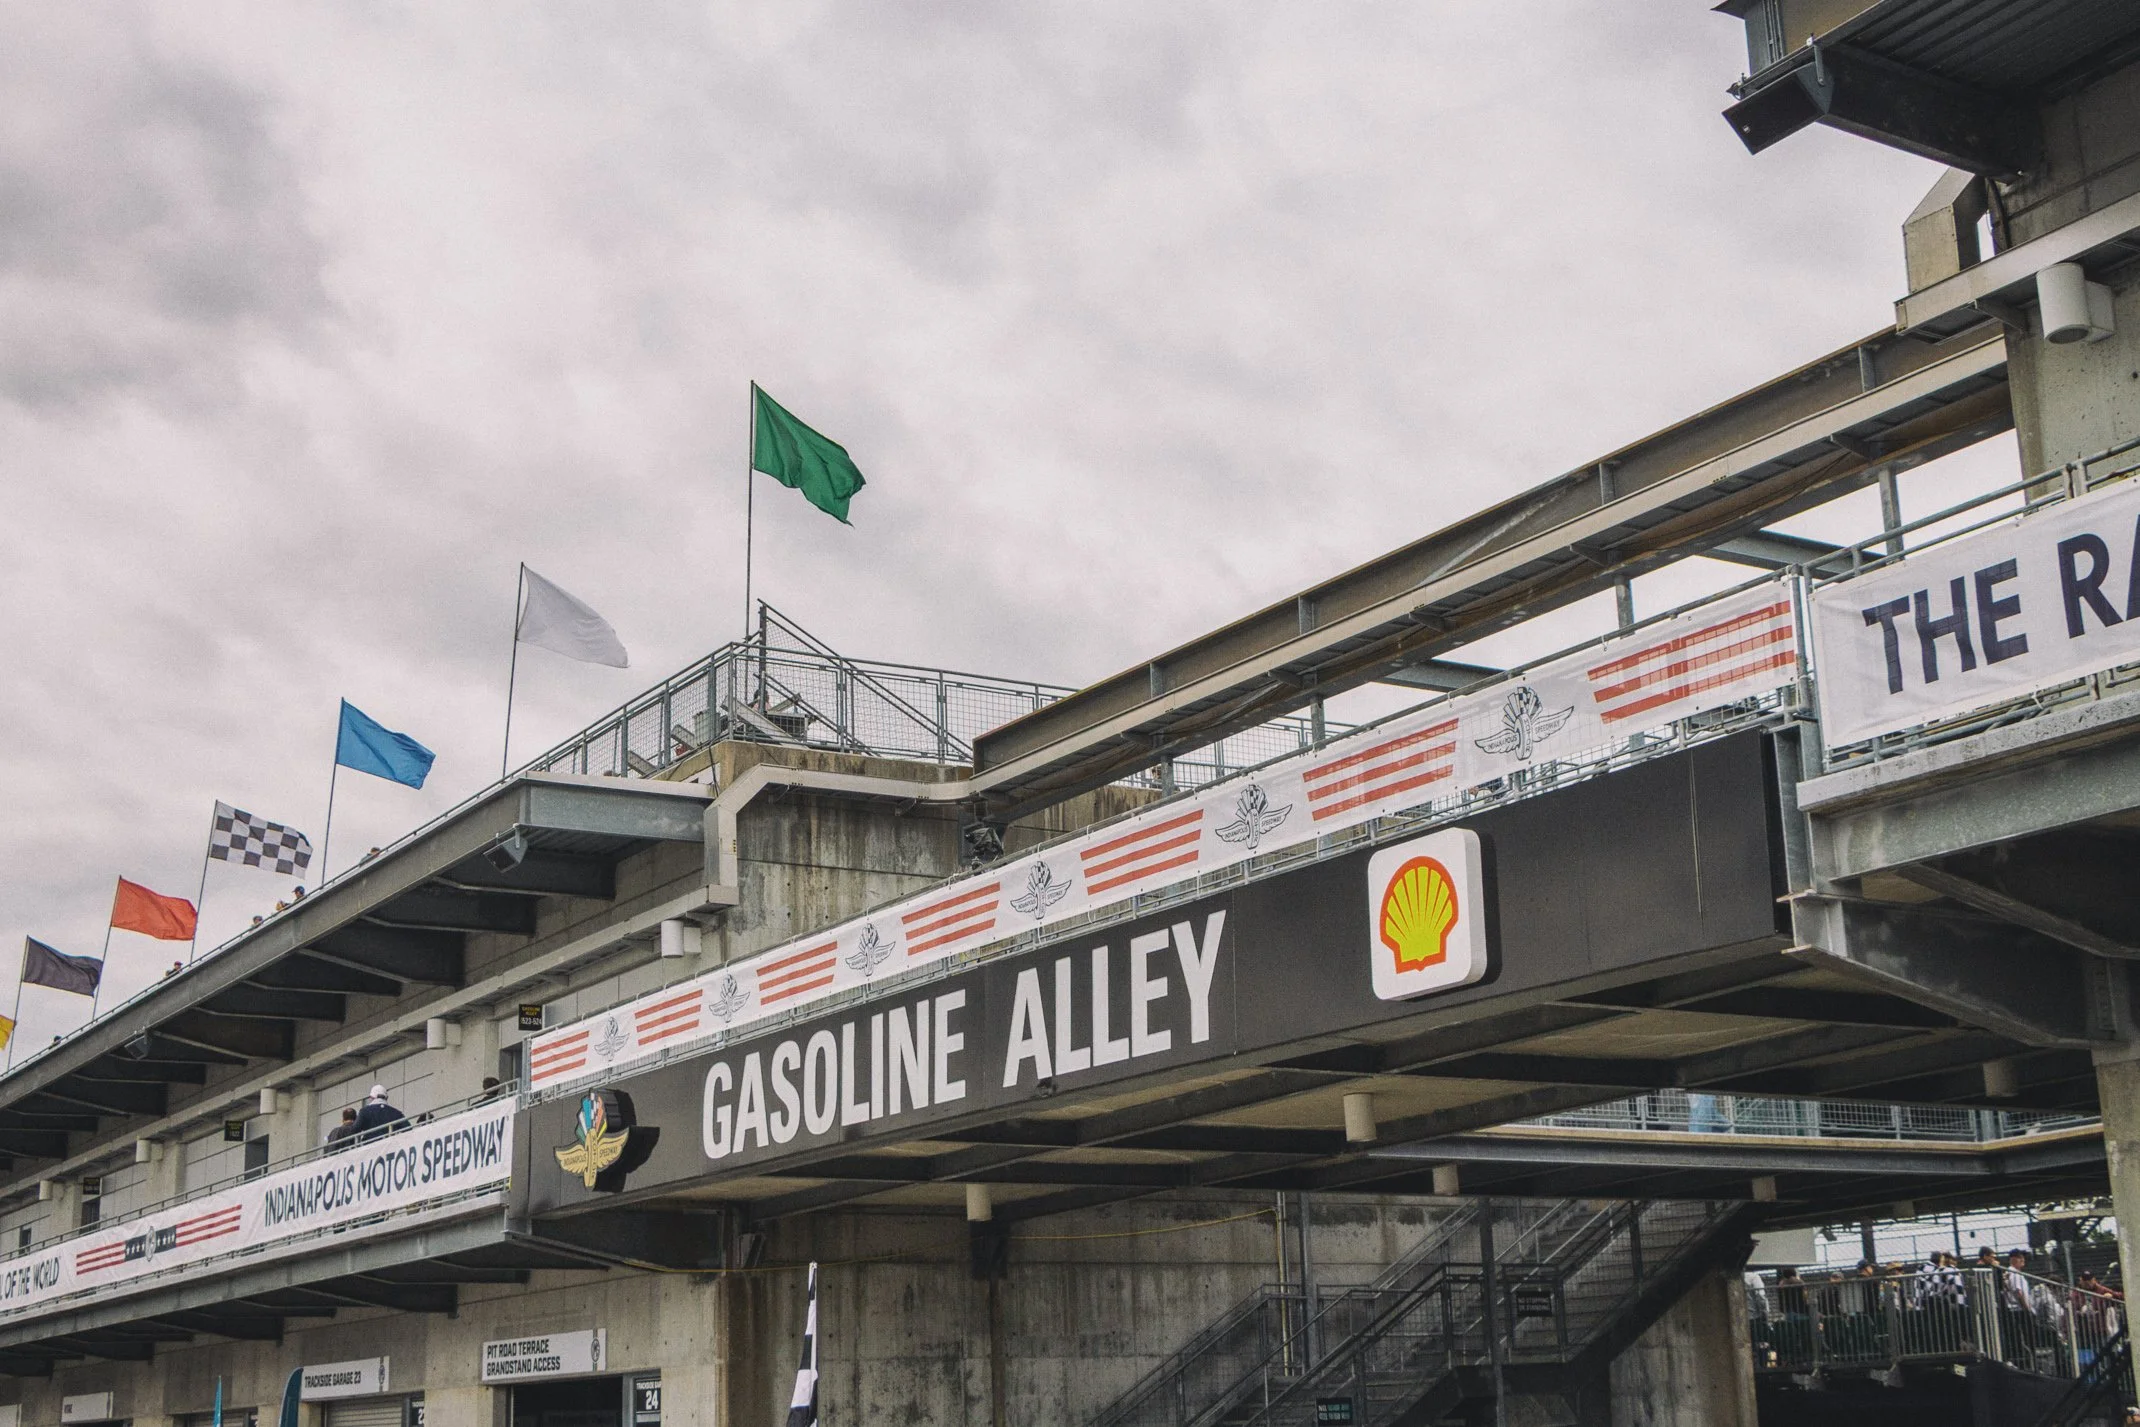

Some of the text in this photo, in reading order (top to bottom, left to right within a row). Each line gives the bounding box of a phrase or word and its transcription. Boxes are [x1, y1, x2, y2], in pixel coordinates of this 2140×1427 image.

[1862, 513, 2140, 695] THE R
[702, 909, 1227, 1159] GASOLINE ALLEY
[265, 1116, 506, 1228] INDIANAPOLIS MOTOR SPEEDWAY
[4, 1270, 17, 1299] OF
[18, 1266, 30, 1297] THE
[33, 1256, 60, 1292] WORLD
[487, 1339, 549, 1359] PIT ROAD TERRACE
[304, 1373, 332, 1389] TRACKSIDE
[332, 1371, 353, 1387] GARAGE
[354, 1370, 361, 1385] 23
[486, 1356, 561, 1377] GRANDSTAND ACCESS
[645, 1389, 659, 1410] 24
